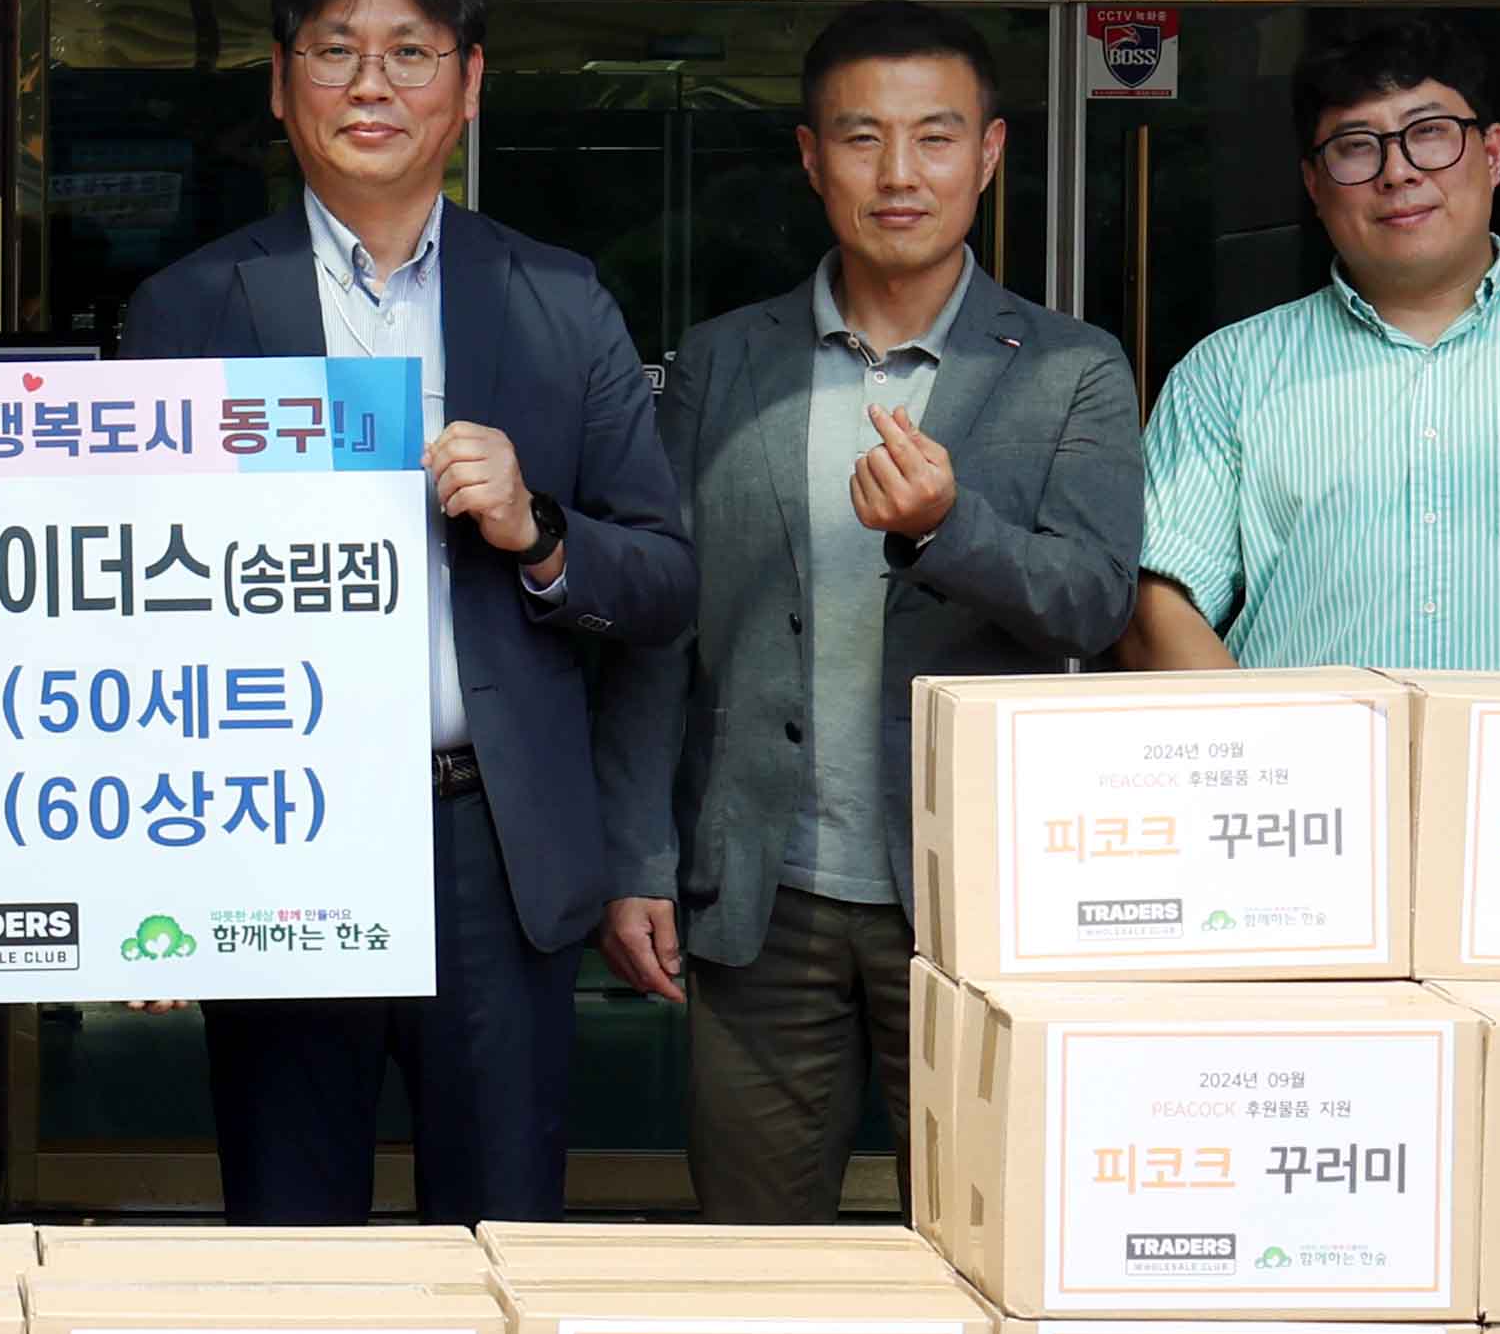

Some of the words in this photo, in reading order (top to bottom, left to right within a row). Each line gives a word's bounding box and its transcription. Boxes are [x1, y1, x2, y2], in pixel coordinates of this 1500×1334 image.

[1096, 11, 1132, 21] CCTV
[1110, 49, 1156, 65] BOSS
[3, 767, 327, 846] (60상자)
[213, 923, 325, 952] 함께하는
[336, 923, 391, 951] 한숲
[24, 950, 67, 964] CLUB
